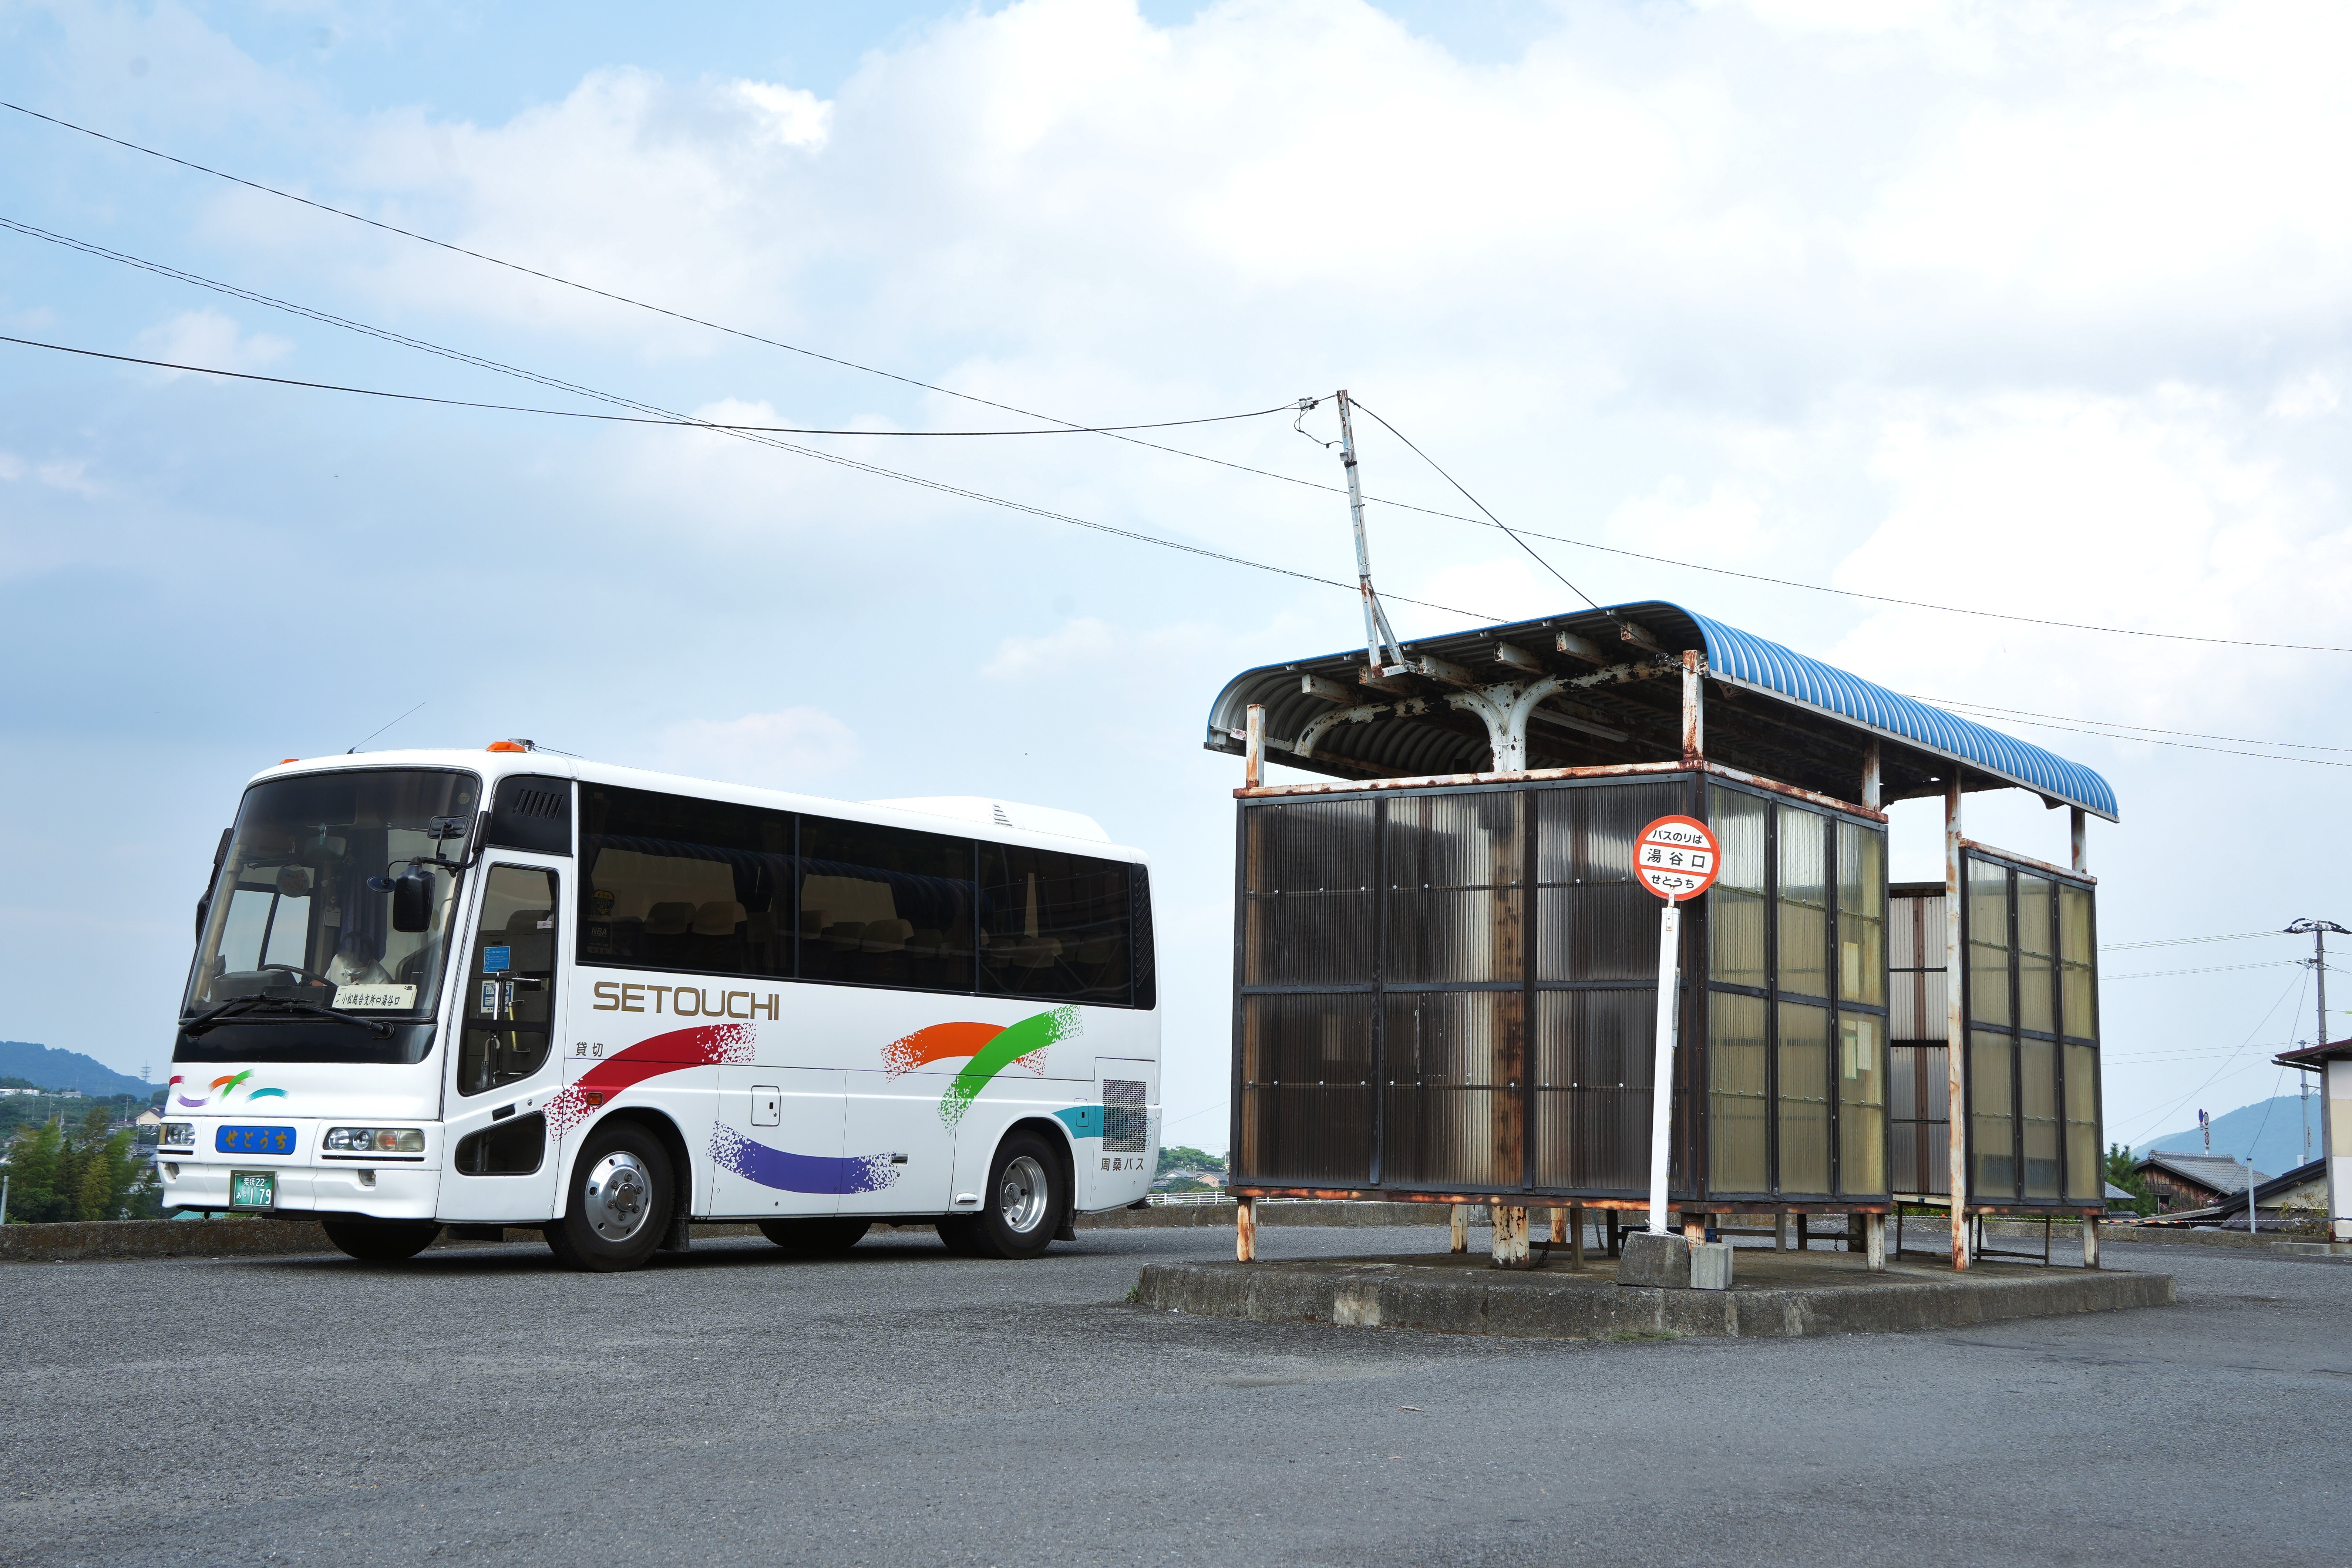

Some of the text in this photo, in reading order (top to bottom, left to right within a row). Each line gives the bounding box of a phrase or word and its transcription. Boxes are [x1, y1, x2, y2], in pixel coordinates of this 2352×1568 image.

[1653, 830, 1703, 844] バスのりば
[1647, 848, 1705, 868] 湯谷口
[1652, 875, 1694, 889] せとうち
[592, 927, 607, 935] NBA
[593, 981, 779, 1020] SETOUCHI
[576, 1042, 603, 1057] 貸切
[225, 1130, 287, 1149] せとうち
[1101, 1158, 1144, 1171] 周桑バス
